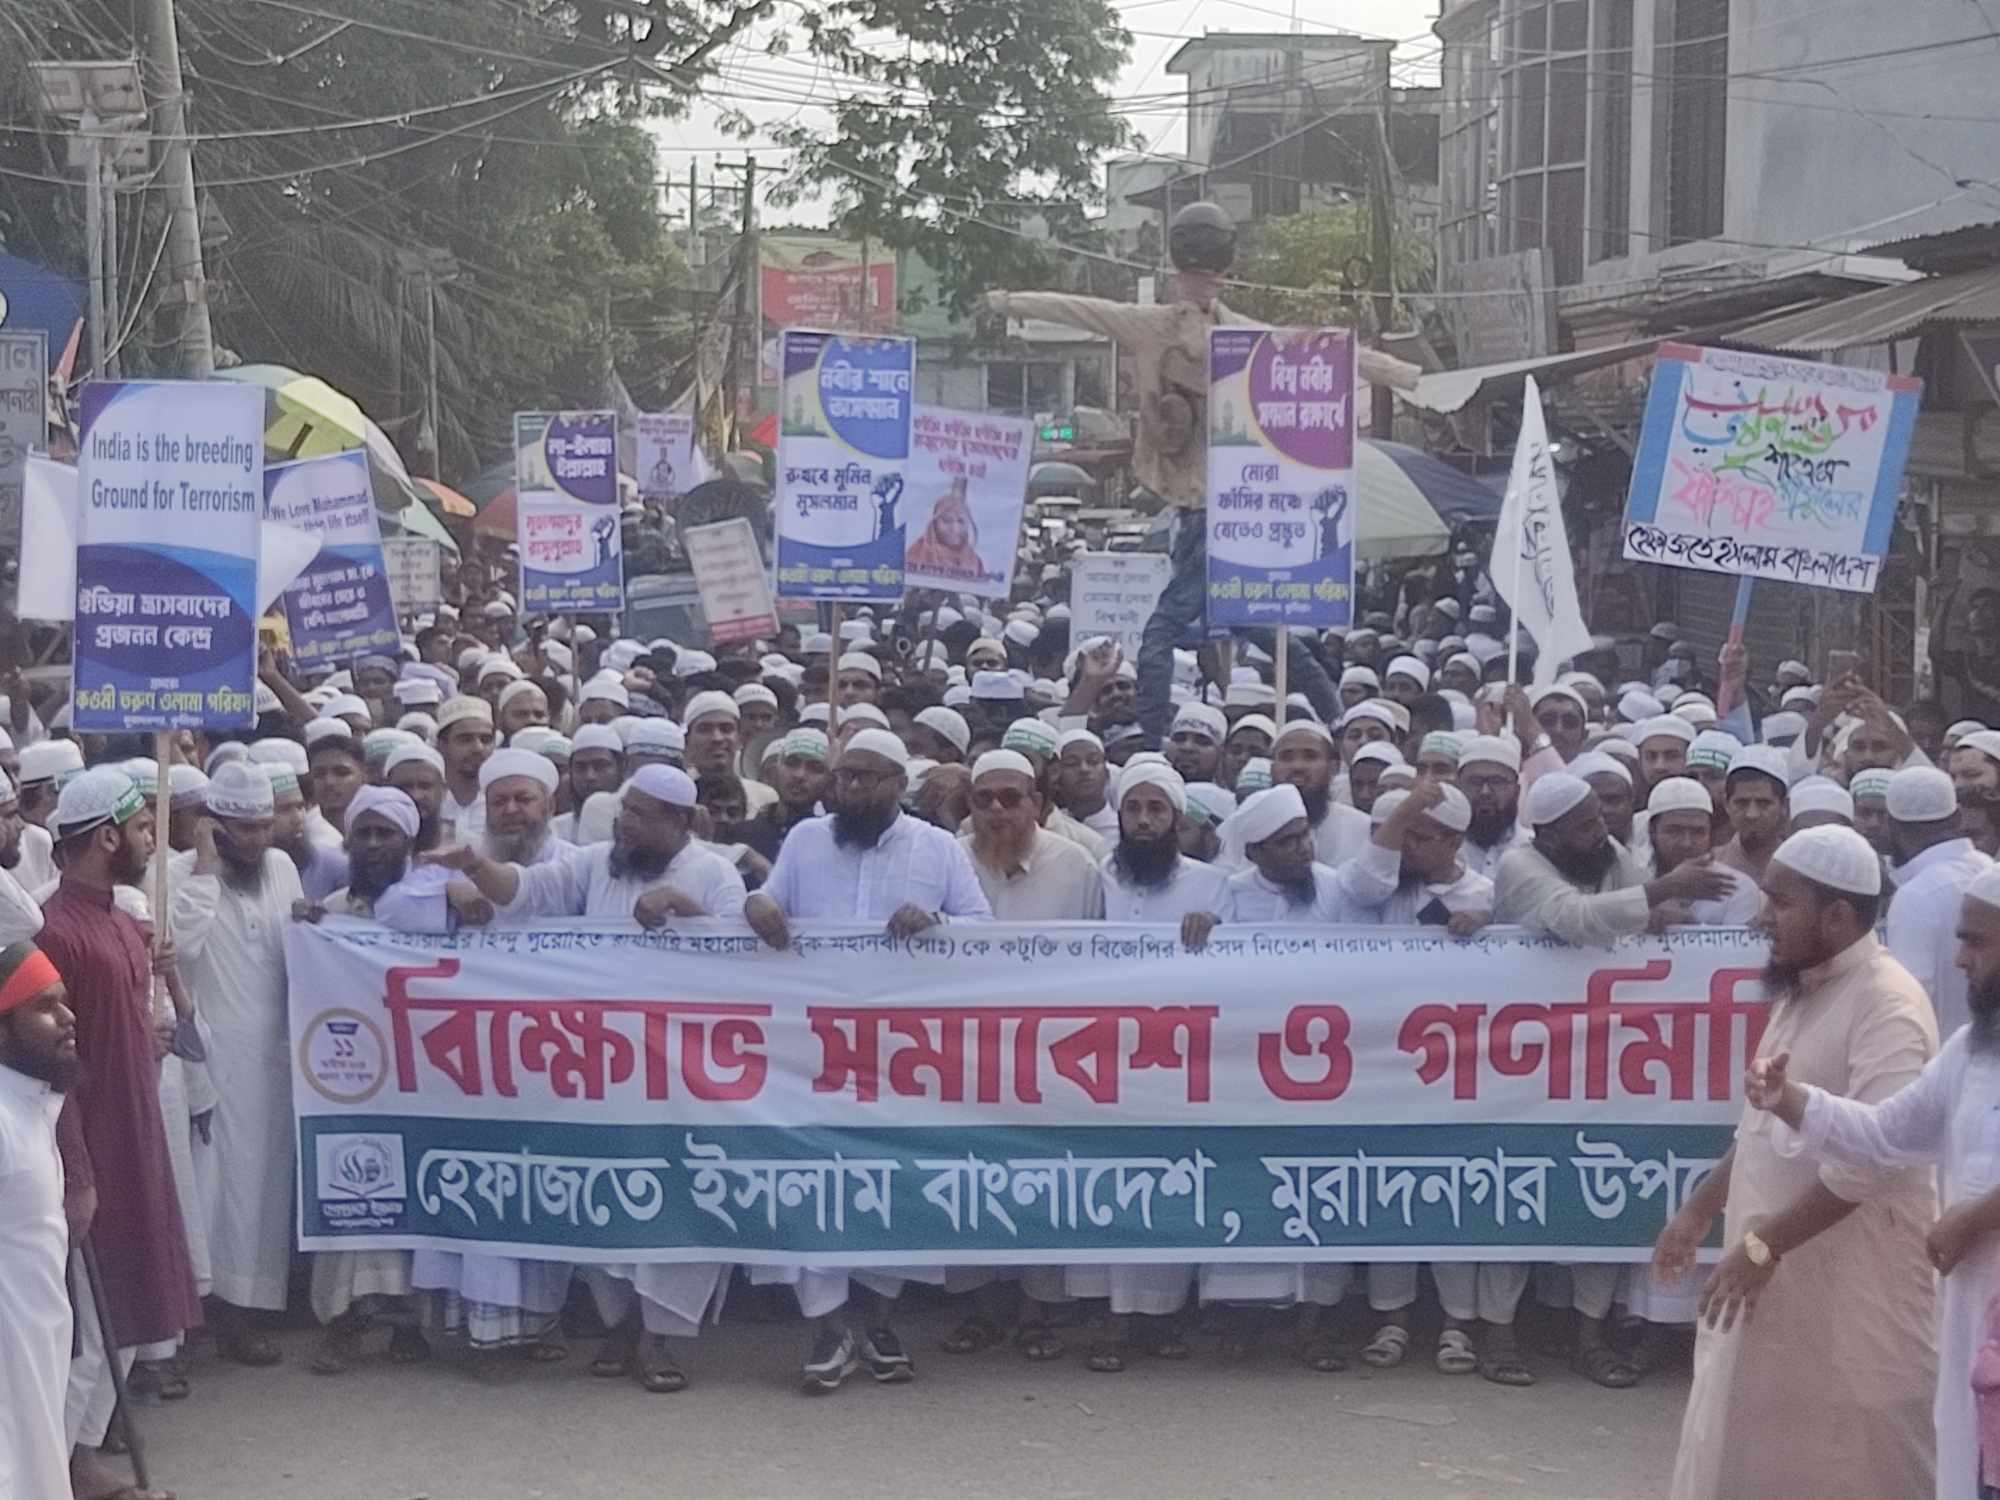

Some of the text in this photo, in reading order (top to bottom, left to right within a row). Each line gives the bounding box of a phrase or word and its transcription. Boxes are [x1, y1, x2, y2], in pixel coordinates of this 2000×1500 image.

[821, 360, 864, 392] নবীর
[1299, 356, 1333, 392] নবীর
[92, 432, 254, 472] India is the breeding
[1241, 463, 1280, 484] মোরা
[91, 480, 256, 513] Ground for Terrorism
[95, 624, 214, 650] প্রজনন কেন্দ্র
[76, 683, 116, 712] কওমী
[962, 937, 993, 957] কে
[1066, 940, 1083, 957] ও
[1091, 934, 1175, 959] বিজেপির
[1252, 932, 1316, 954] নিতেশ
[382, 957, 773, 1101] বিক্ষোভ
[806, 1003, 1220, 1104] সমাবেশ
[1258, 1004, 1354, 1101] ও
[416, 1145, 672, 1227] হেফাজতে
[682, 1132, 902, 1233] ইসলাম
[1259, 1146, 1558, 1246] মুরাদনগর
